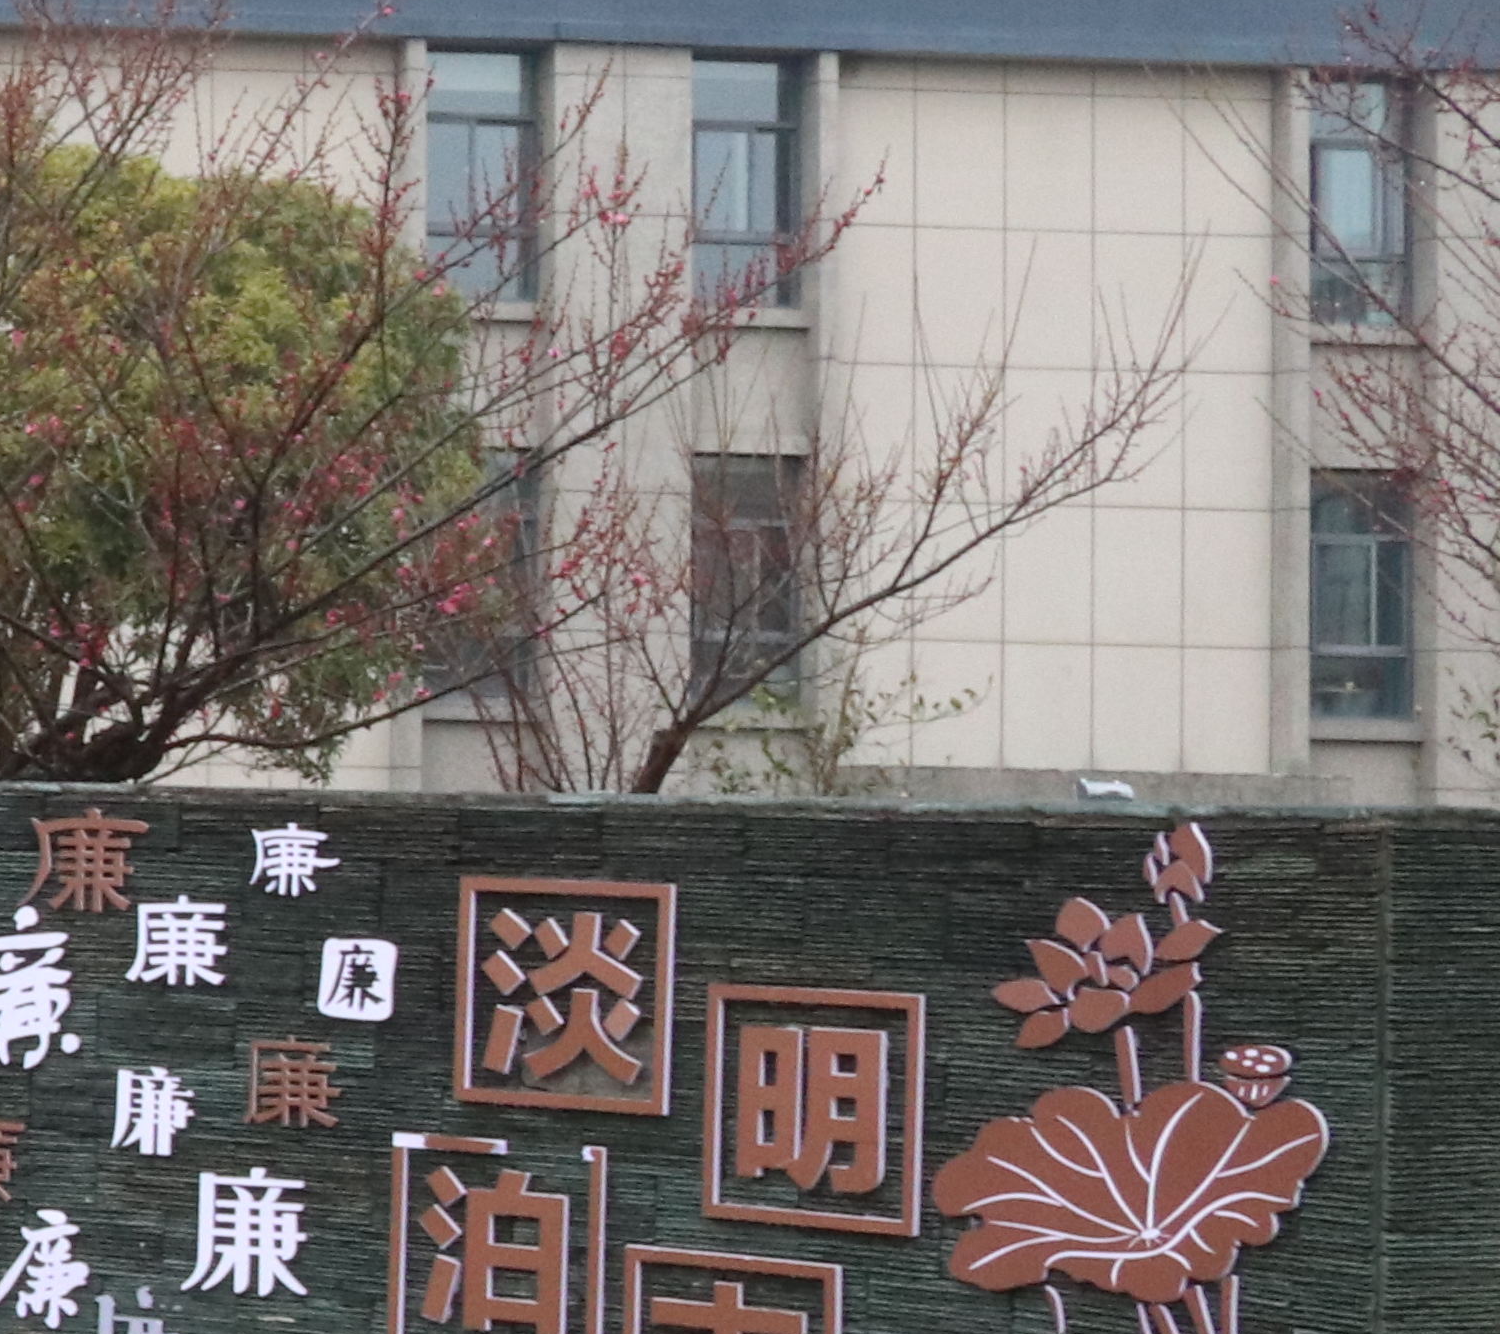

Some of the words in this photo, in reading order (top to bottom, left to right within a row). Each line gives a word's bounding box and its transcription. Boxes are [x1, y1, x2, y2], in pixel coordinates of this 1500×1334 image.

[19, 808, 149, 913] 廉
[249, 822, 341, 897] 廉
[125, 894, 227, 987] 廉
[326, 944, 385, 1012] 廉
[110, 1067, 196, 1156] 廉
[244, 1035, 342, 1128] 廉
[180, 1167, 308, 1297] 廉
